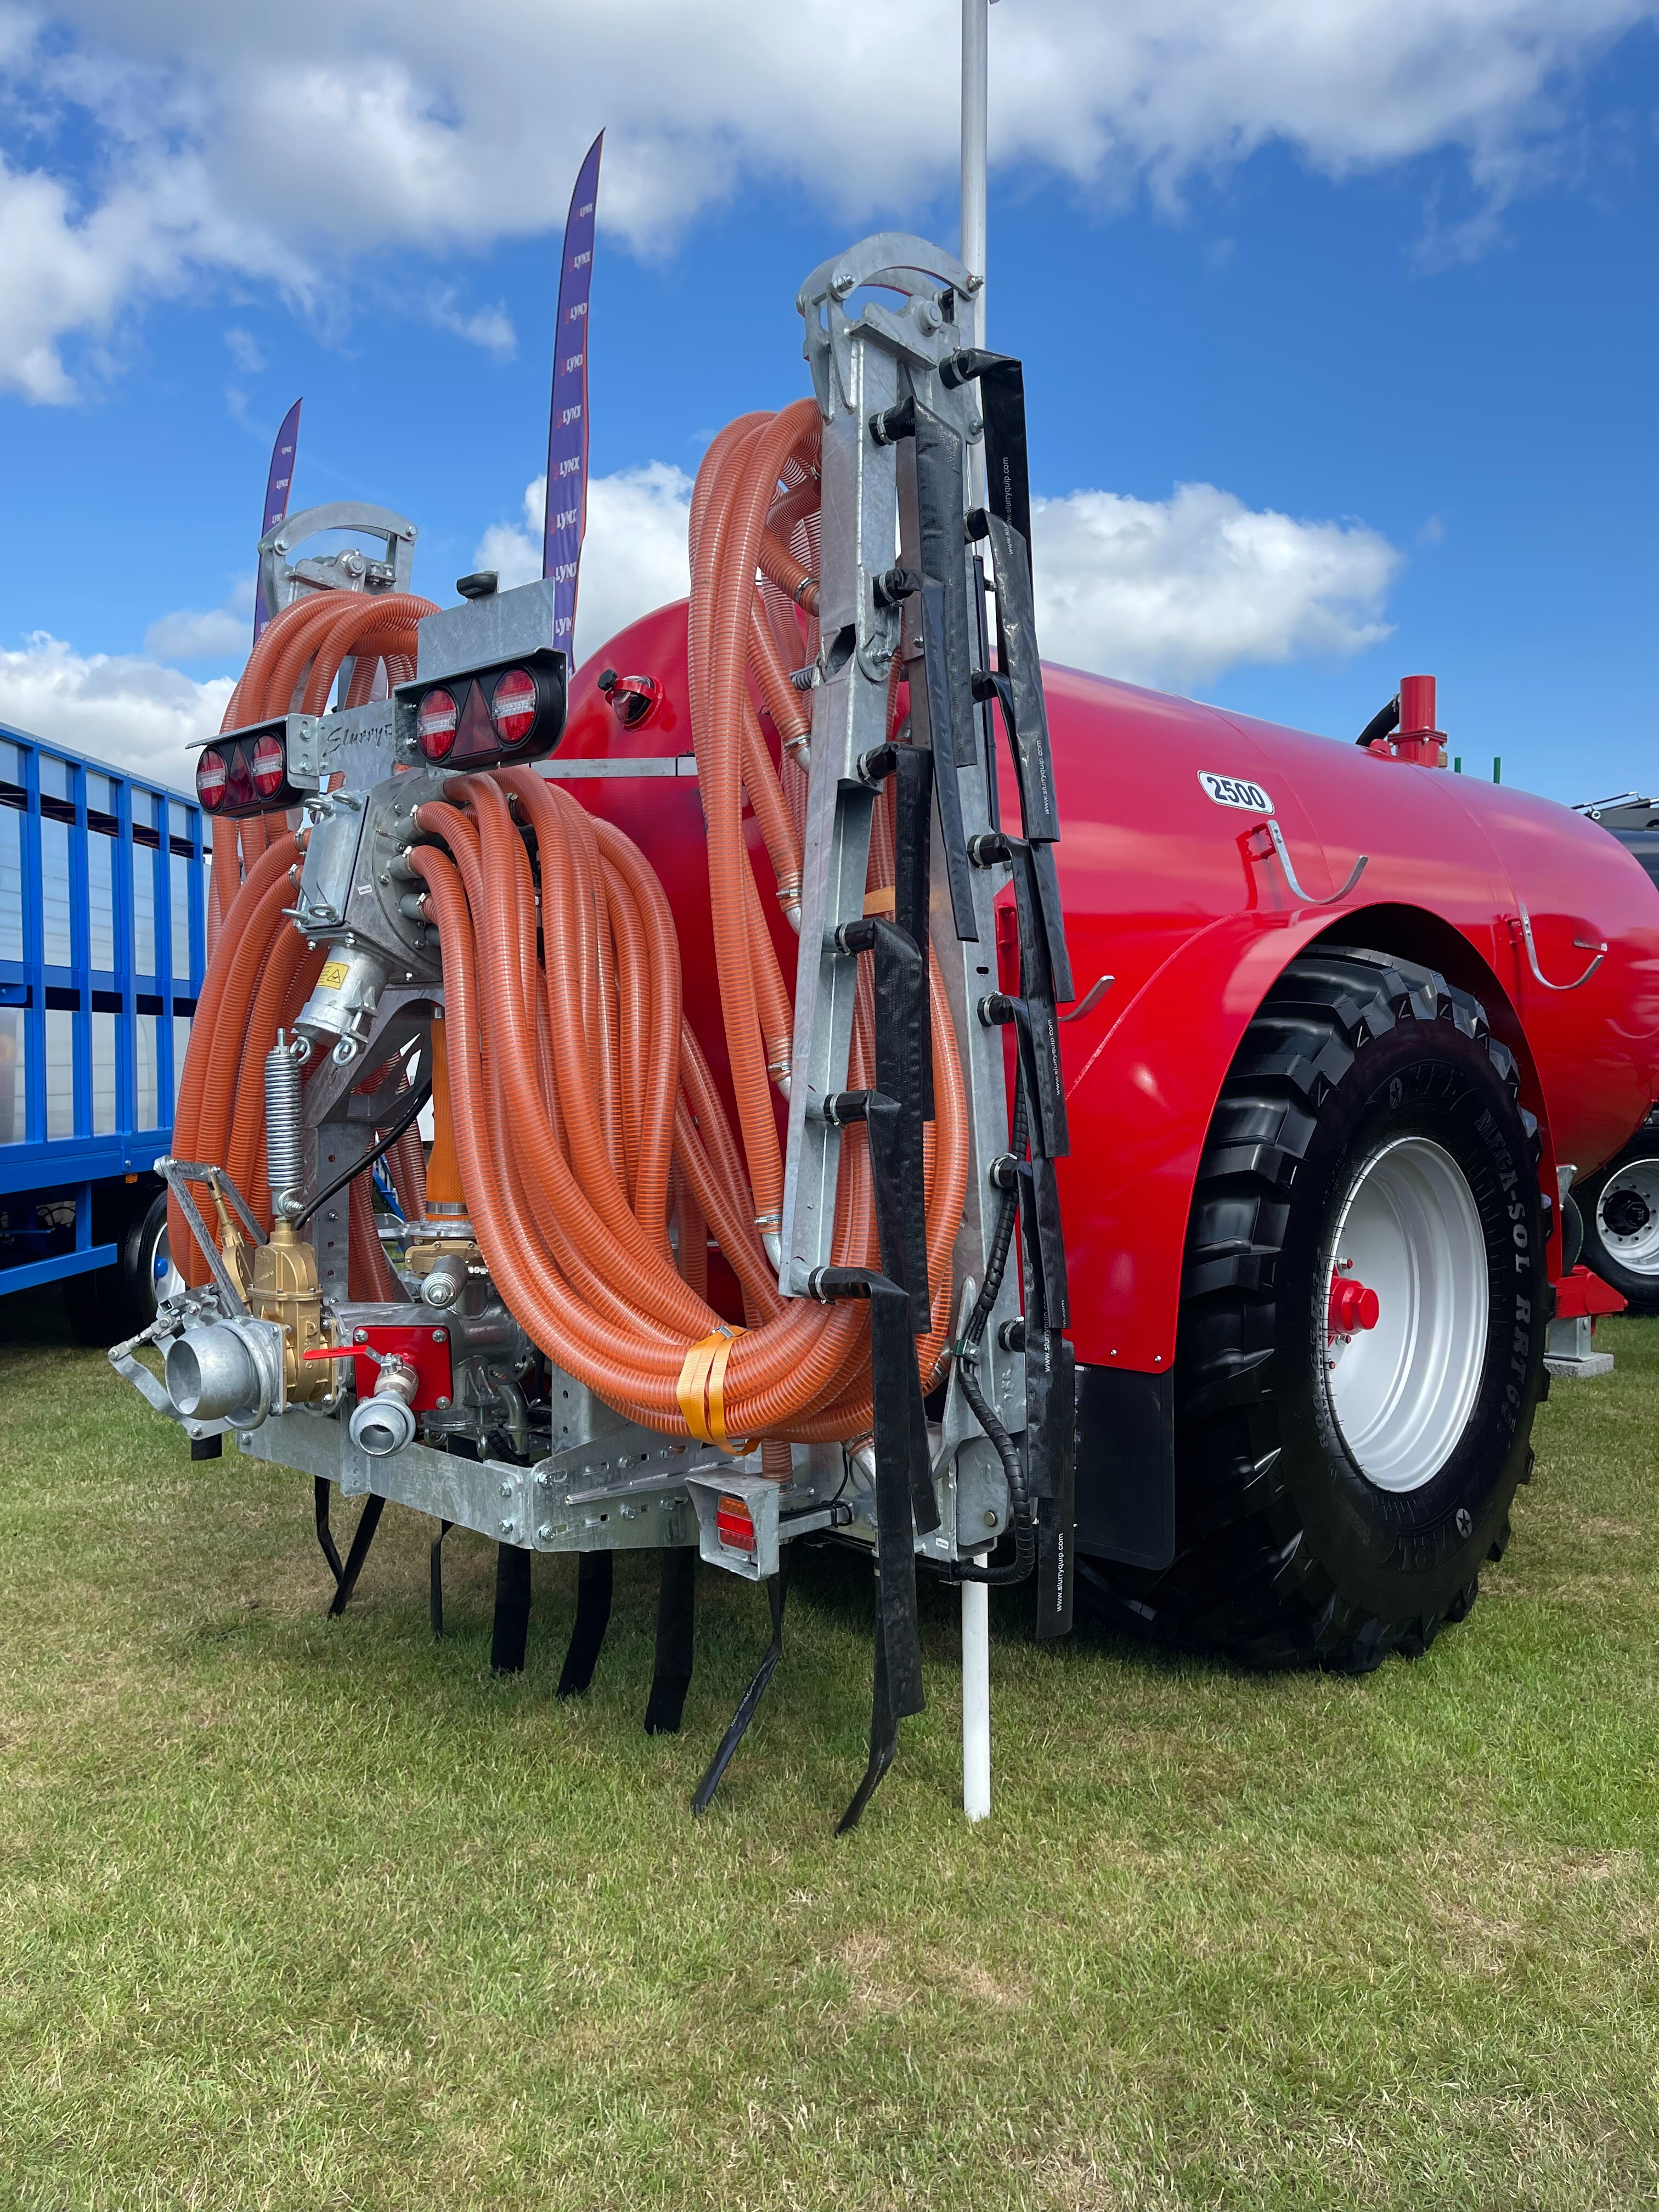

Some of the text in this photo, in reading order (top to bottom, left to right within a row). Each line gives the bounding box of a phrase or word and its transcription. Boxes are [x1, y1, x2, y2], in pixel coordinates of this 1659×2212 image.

[574, 250, 591, 269] LYNX
[562, 404, 582, 425] LYNX
[560, 456, 580, 478] LYNX
[557, 508, 577, 531] LYNX
[555, 616, 573, 636] LYN
[1036, 740, 1050, 815] www.slurryquip.com
[1206, 776, 1266, 809] 2500
